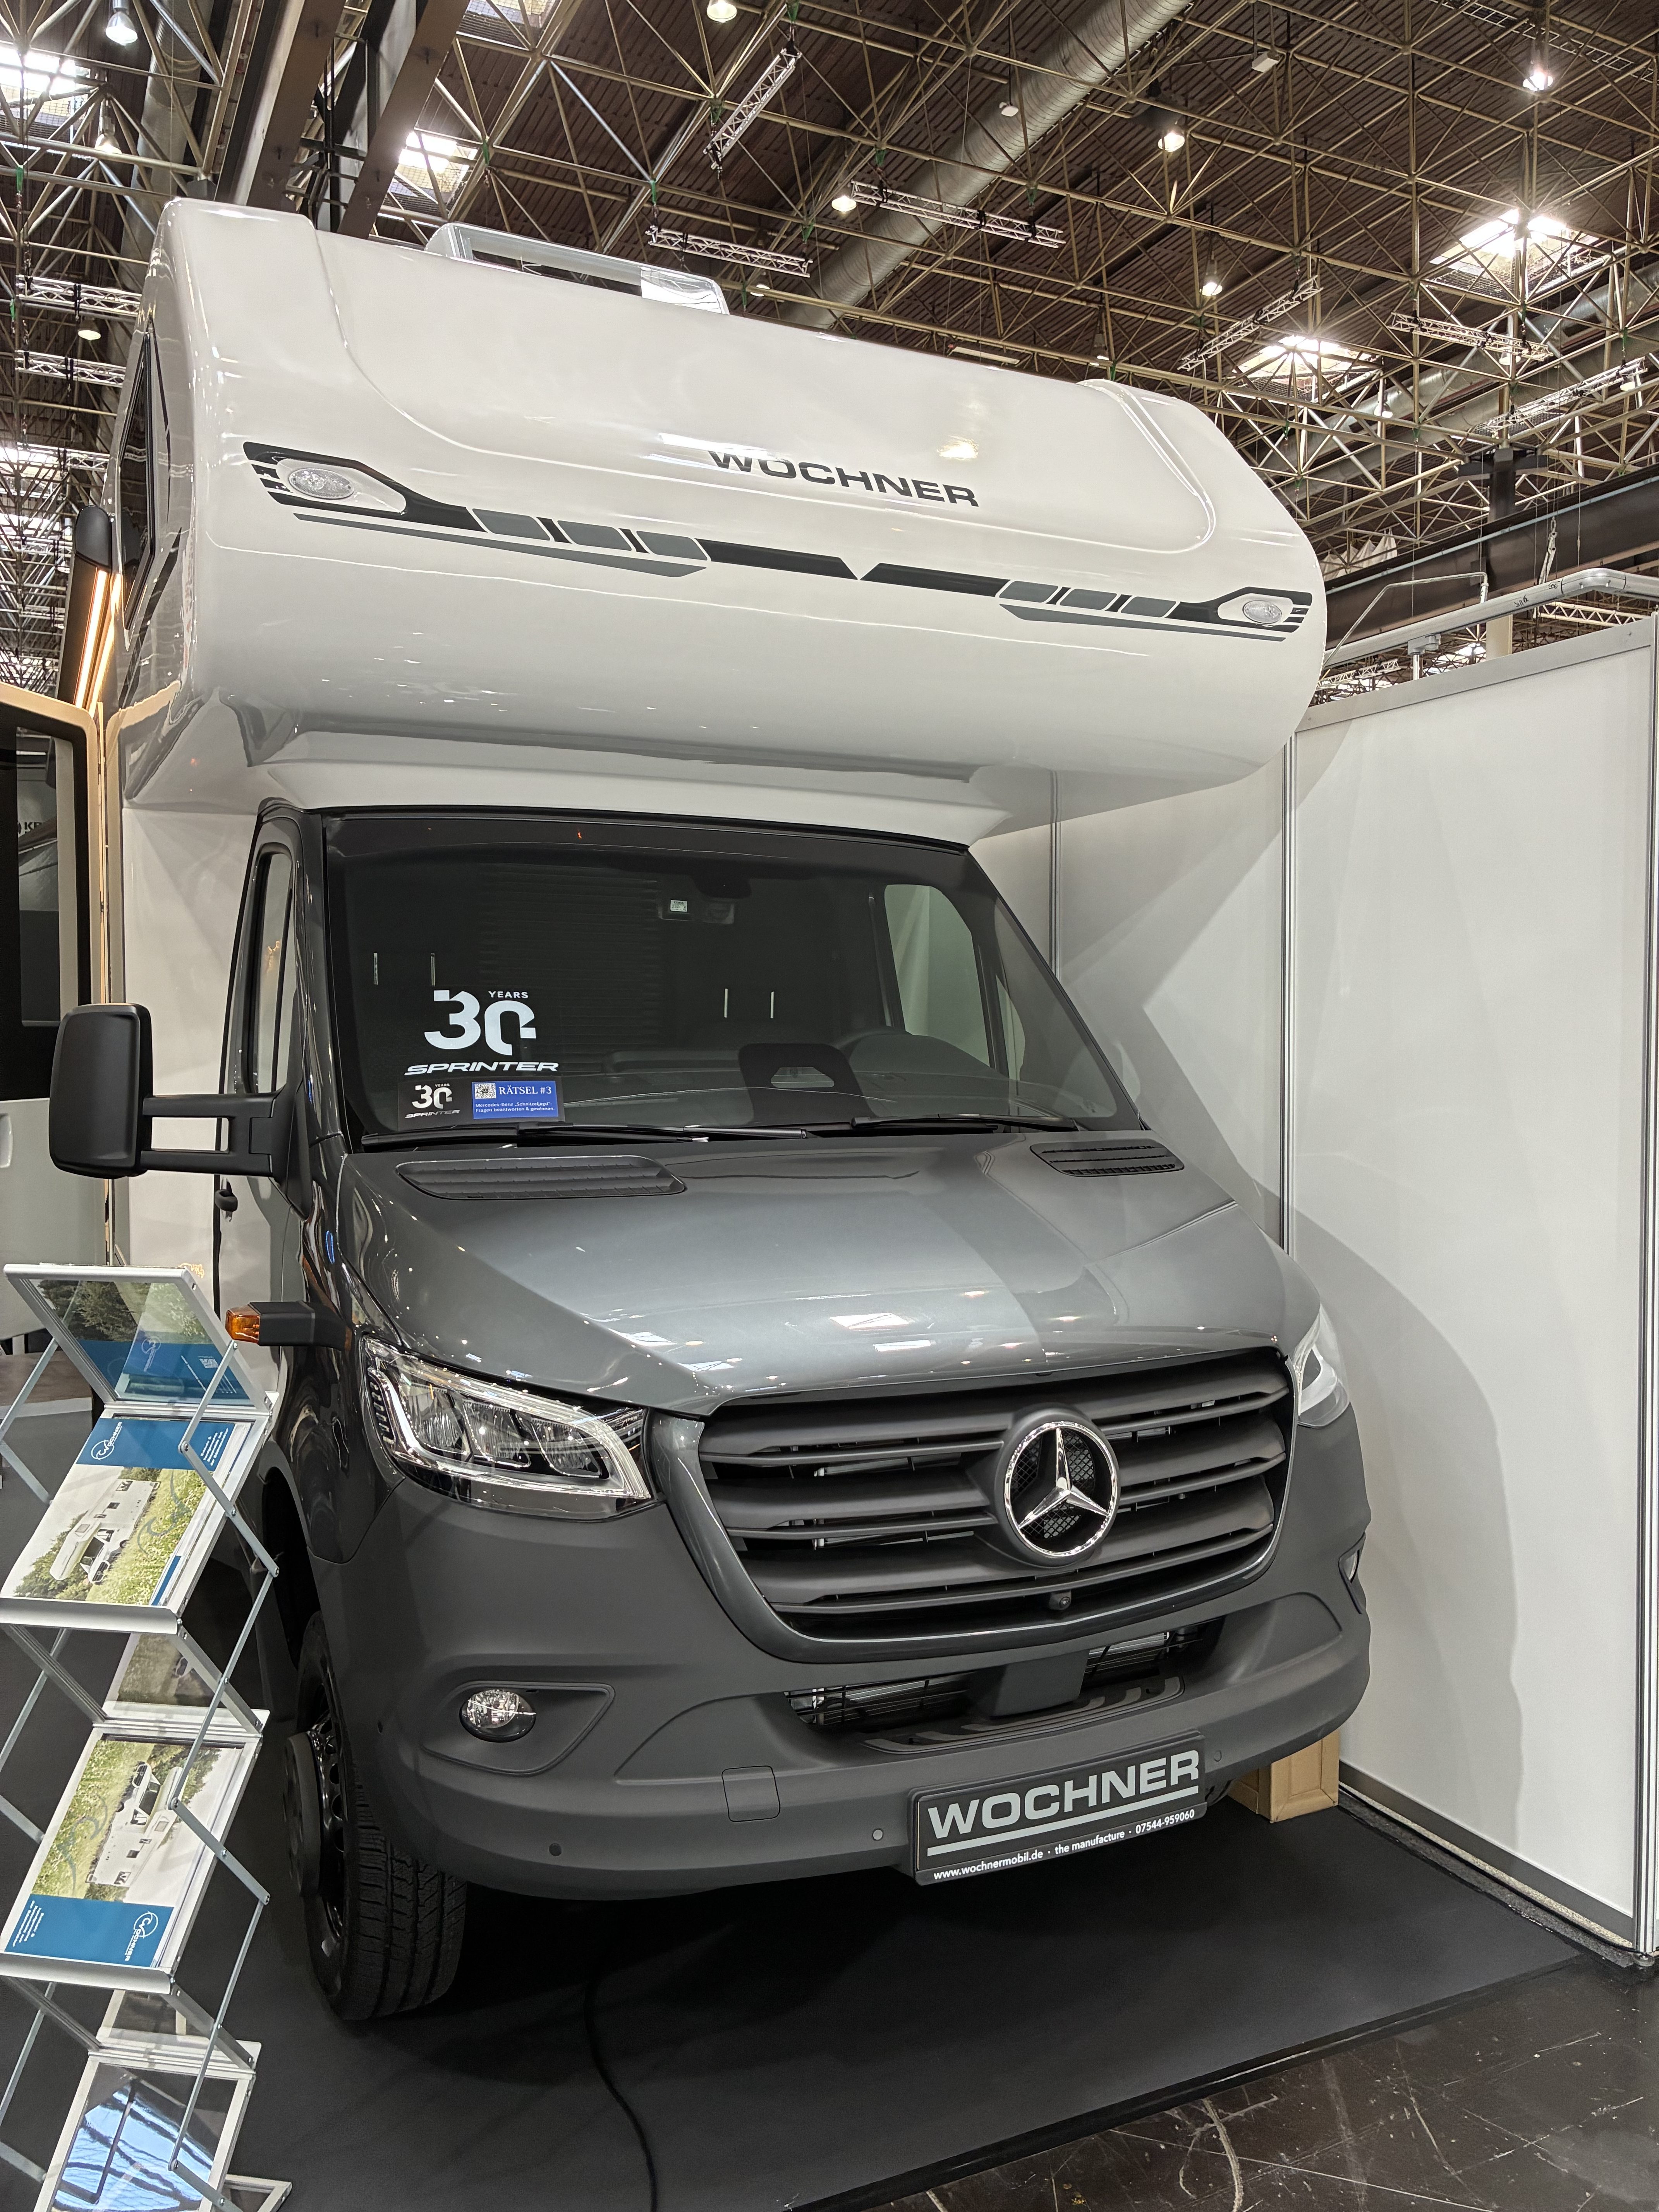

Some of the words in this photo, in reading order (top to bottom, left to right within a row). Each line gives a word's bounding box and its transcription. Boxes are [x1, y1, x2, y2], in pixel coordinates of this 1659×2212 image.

[708, 449, 979, 507] WOCHNER
[424, 990, 536, 1056] 30
[404, 1061, 559, 1076] SPRINTER
[412, 1085, 453, 1109] 30
[498, 1085, 538, 1095] RÄTSEL
[540, 1086, 552, 1094] #3
[405, 1109, 460, 1118] SPRINTER
[927, 1750, 1199, 1839] WOCHNER
[933, 1849, 1043, 1880] www.wochnermobil.de
[1054, 1843, 1070, 1855] the
[1071, 1829, 1125, 1852] manufacture
[1135, 1808, 1195, 1834] 07544-959060
